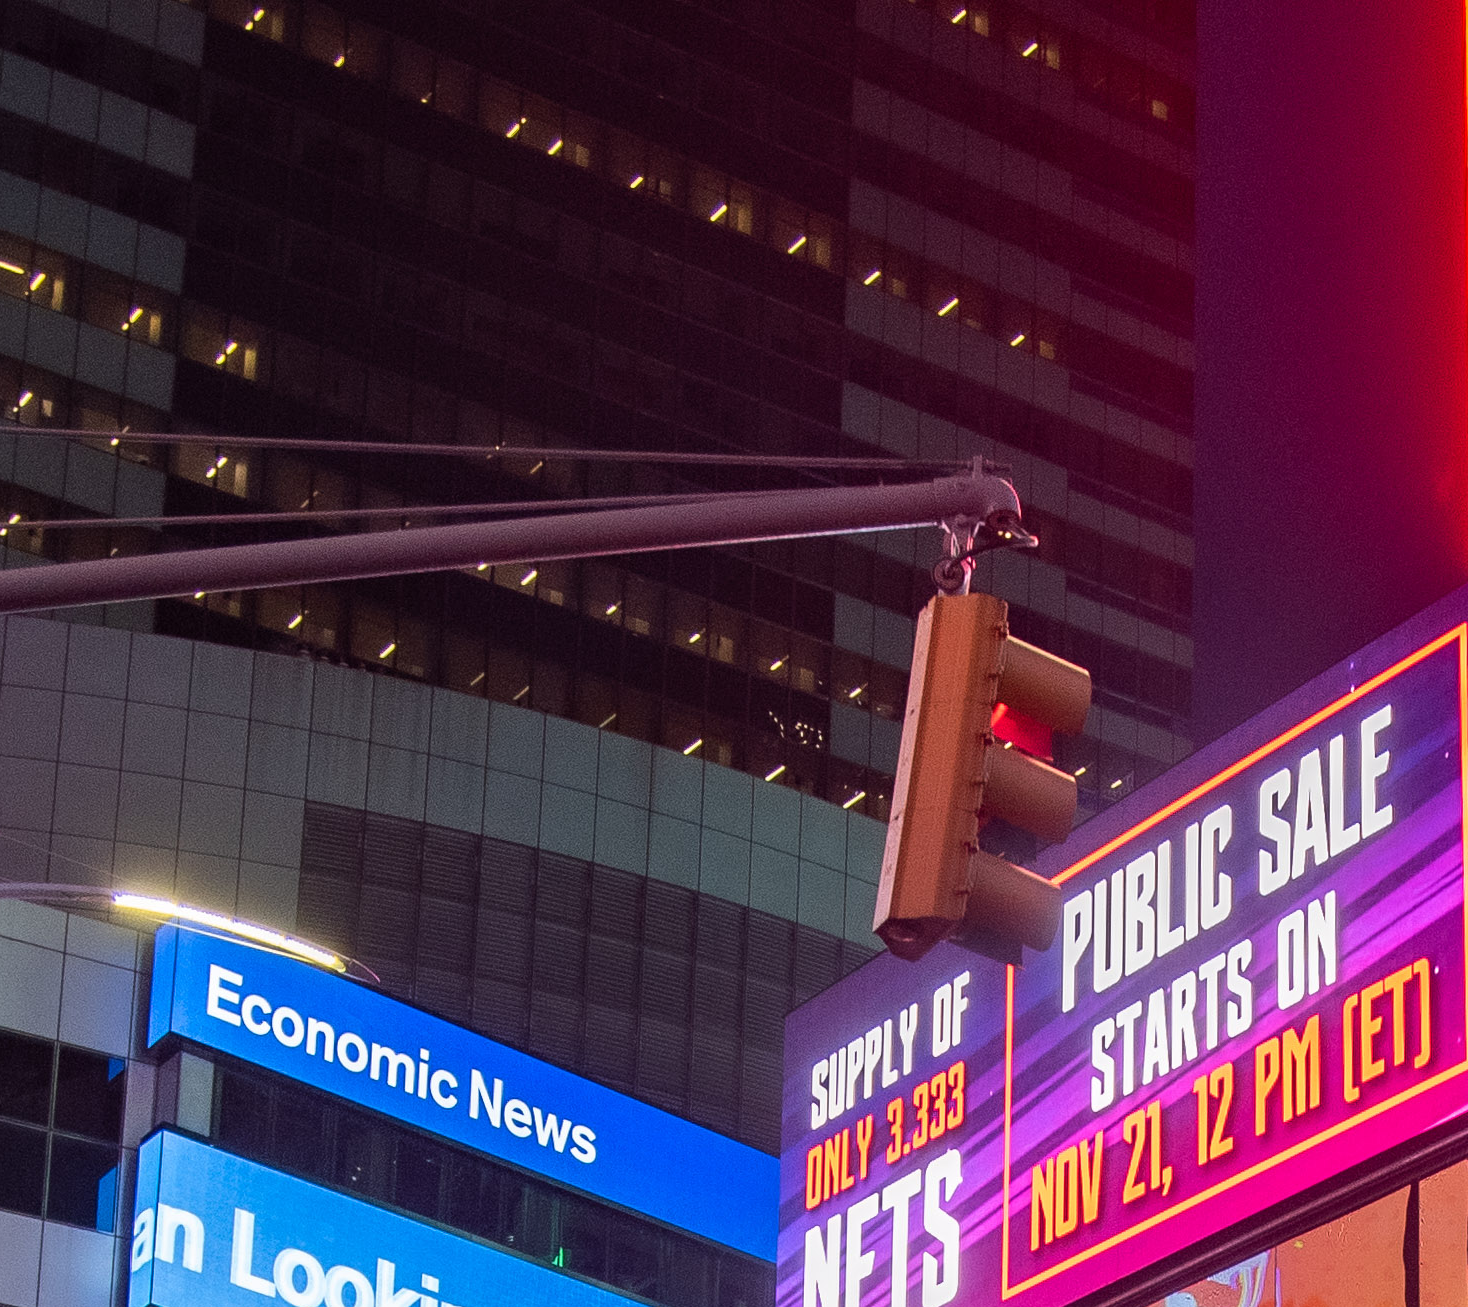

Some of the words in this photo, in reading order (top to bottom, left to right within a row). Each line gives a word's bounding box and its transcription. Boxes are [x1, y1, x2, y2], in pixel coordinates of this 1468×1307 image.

[1062, 804, 1233, 1012] PUBLIC
[1259, 704, 1394, 897] SALE
[206, 965, 458, 1109] Economic
[469, 1069, 598, 1164] News
[811, 1007, 915, 1130] SUPPLY
[934, 972, 970, 1056] OF
[1091, 962, 1254, 1113] STARTS
[1278, 891, 1337, 995] ON
[806, 1123, 873, 1211] ONLY
[886, 1060, 964, 1166] 3.333
[1031, 1148, 1102, 1253] NOV
[1123, 1105, 1173, 1204] 21,
[1195, 1070, 1235, 1156] 12
[1256, 1016, 1321, 1128] PM
